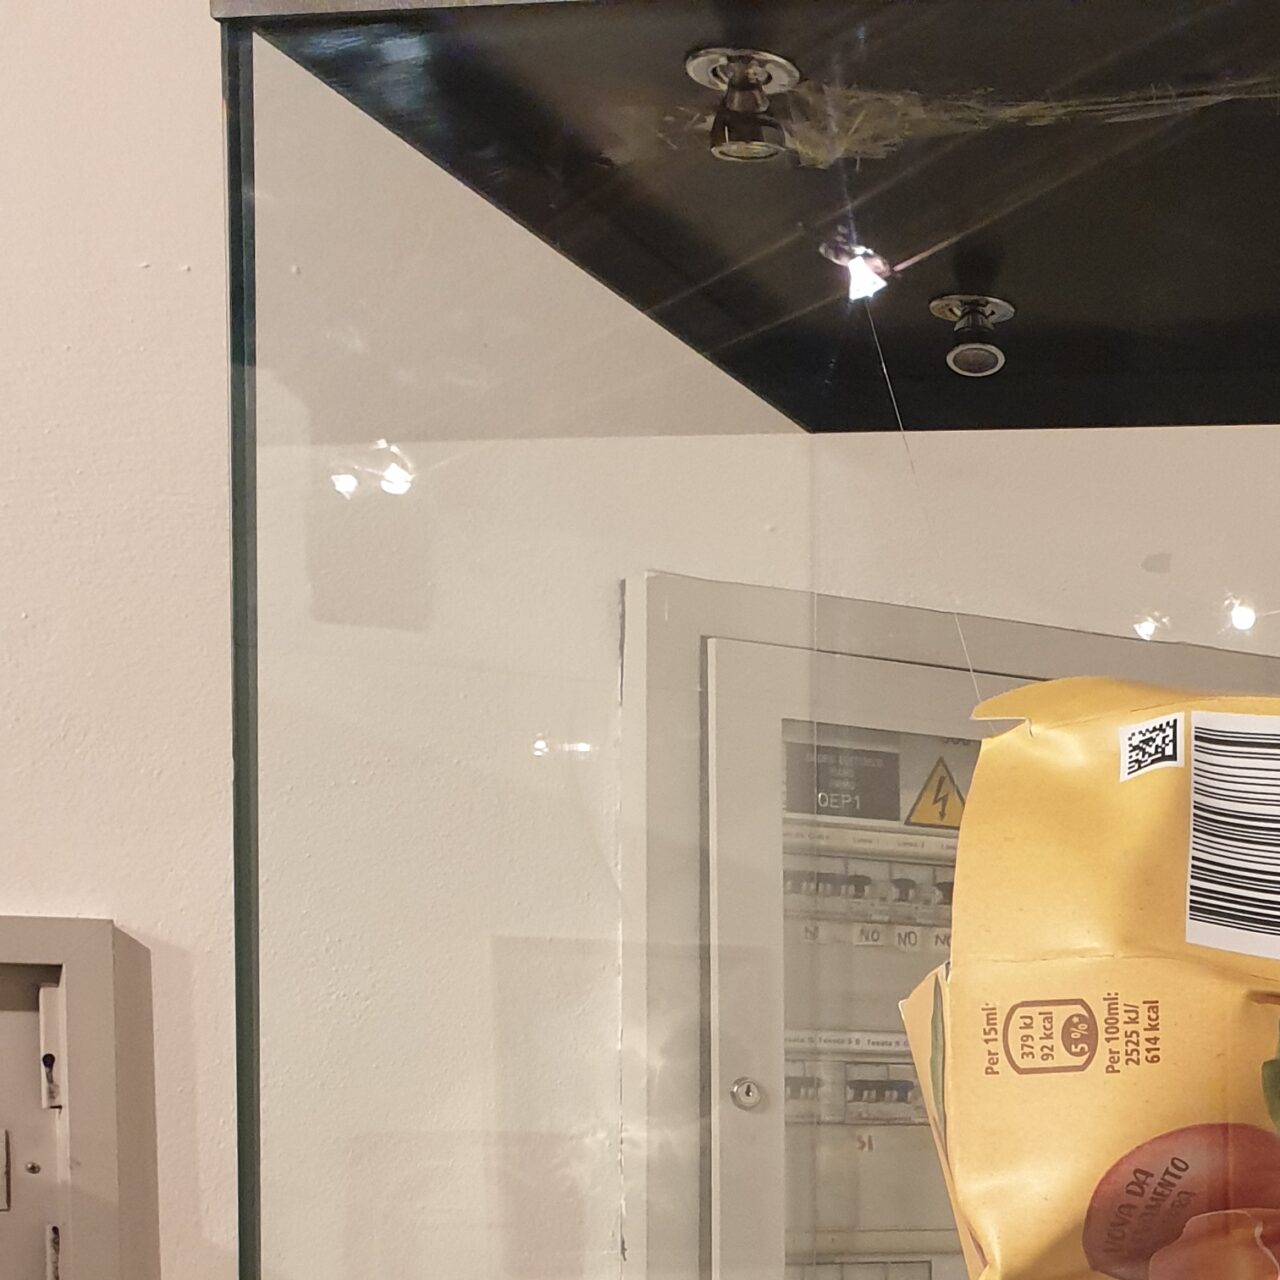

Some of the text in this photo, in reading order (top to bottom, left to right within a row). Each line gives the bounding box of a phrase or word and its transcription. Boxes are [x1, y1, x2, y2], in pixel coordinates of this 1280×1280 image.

[981, 1002, 1000, 1076] Per 15ml:
[1019, 1015, 1035, 1060] 379 kJ
[1038, 1011, 1055, 1061] 92 kcal
[1070, 1043, 1088, 1054] 5
[1103, 992, 1120, 1074] Per 100ml:
[1123, 1003, 1140, 1066] 2525 kJ/
[1142, 1000, 1160, 1064] 614 kcal
[1125, 1167, 1154, 1198] DA
